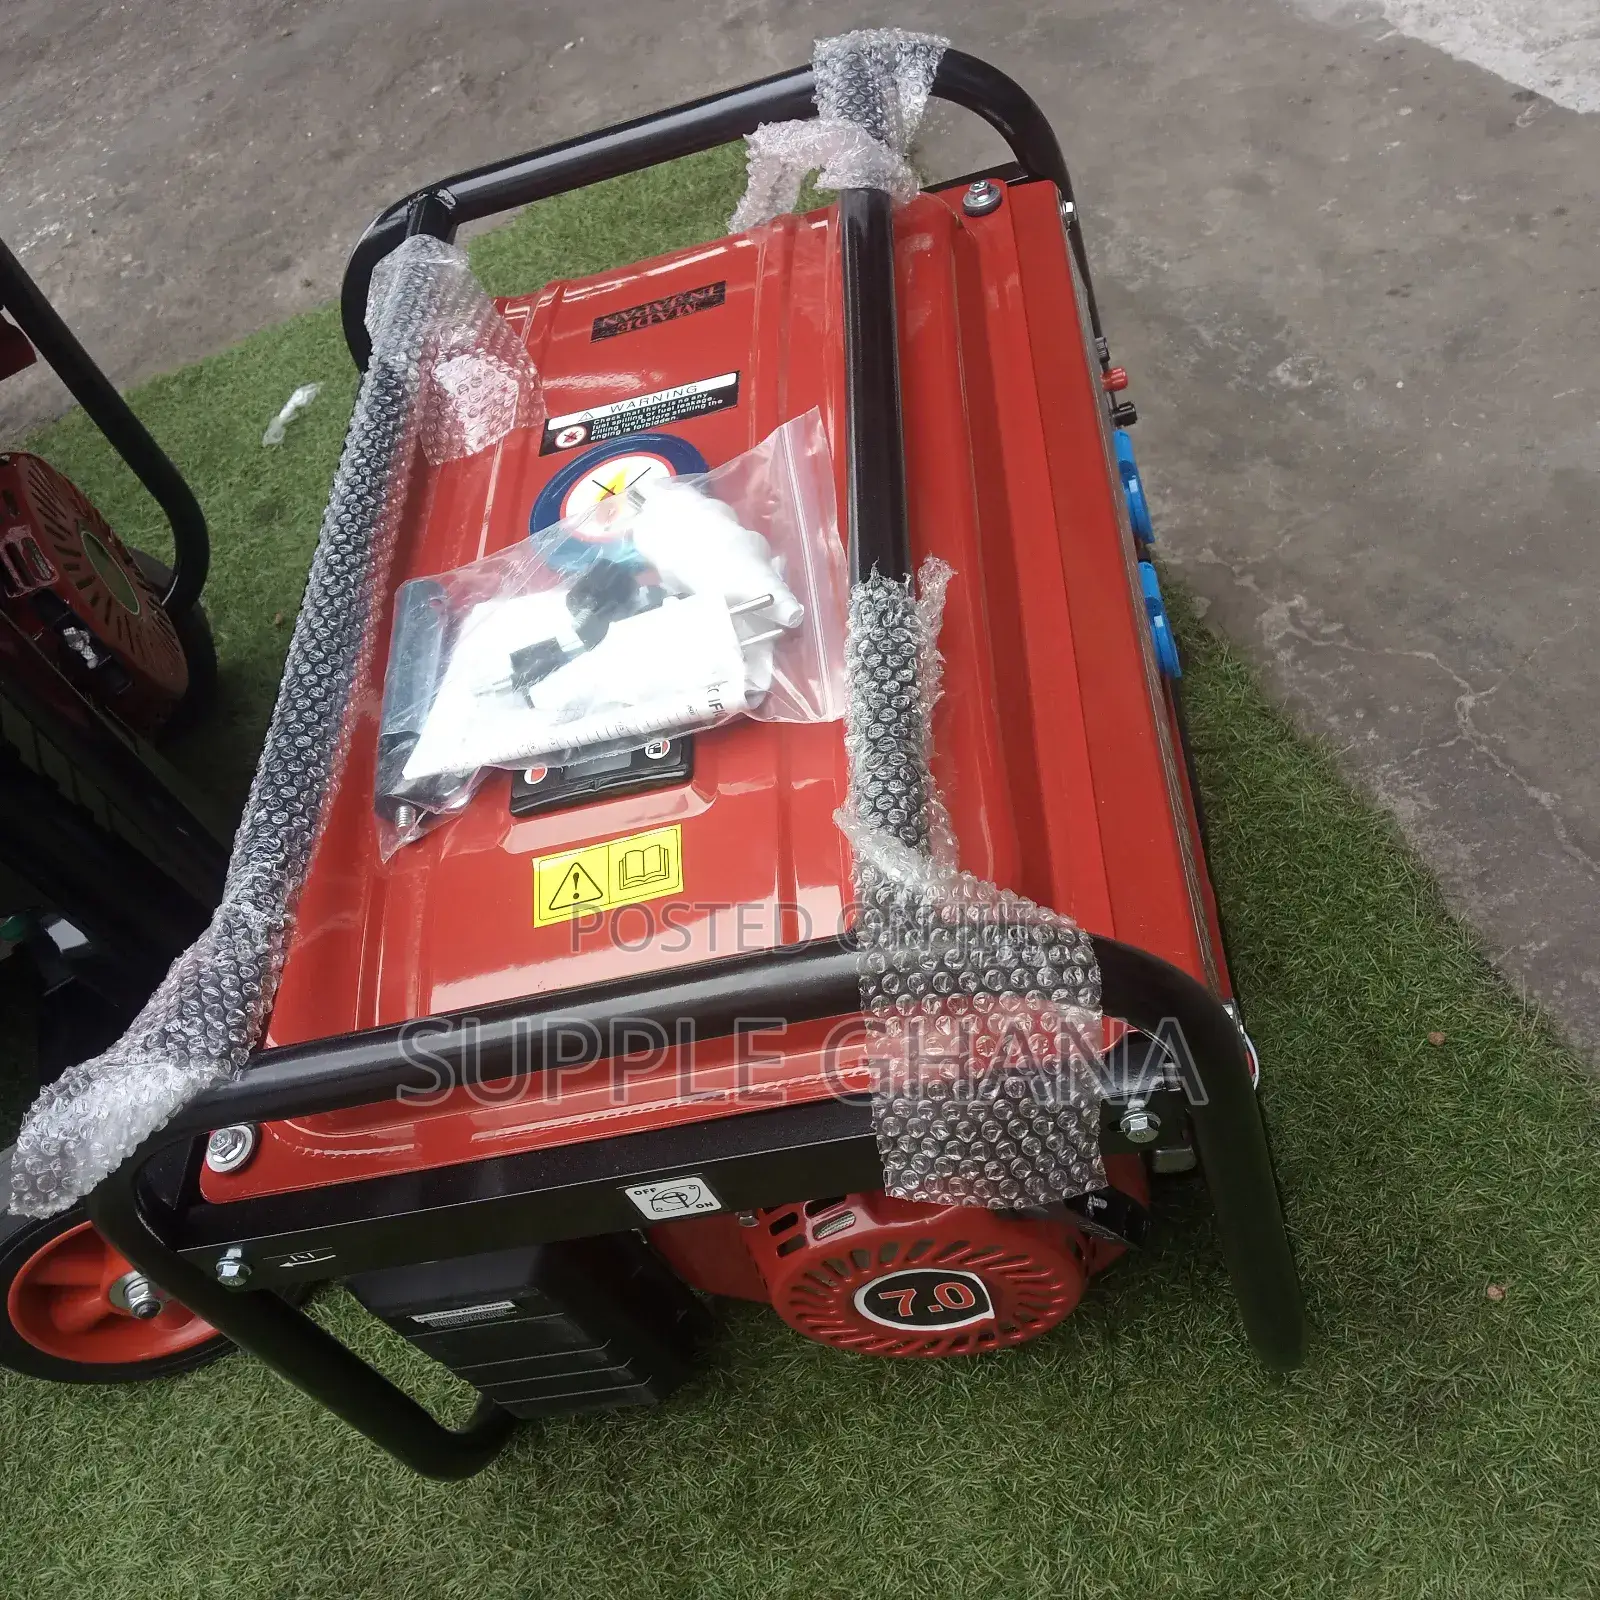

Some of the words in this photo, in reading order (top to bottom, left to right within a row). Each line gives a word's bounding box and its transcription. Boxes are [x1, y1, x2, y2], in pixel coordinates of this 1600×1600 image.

[602, 295, 685, 327] JAPAN
[617, 302, 697, 333] MADE
[594, 414, 621, 425] Check
[623, 410, 640, 418] that
[642, 404, 666, 413] there
[691, 393, 708, 401] any
[610, 385, 698, 414] WARNING
[591, 425, 619, 436] Filling
[621, 420, 639, 428] fuel
[640, 413, 669, 424] before
[708, 399, 723, 407] the
[592, 421, 609, 430] fuel
[611, 414, 643, 426] spilling
[658, 406, 675, 414] fuel
[633, 1188, 657, 1196] OFF
[877, 1281, 977, 1318] 7.0
